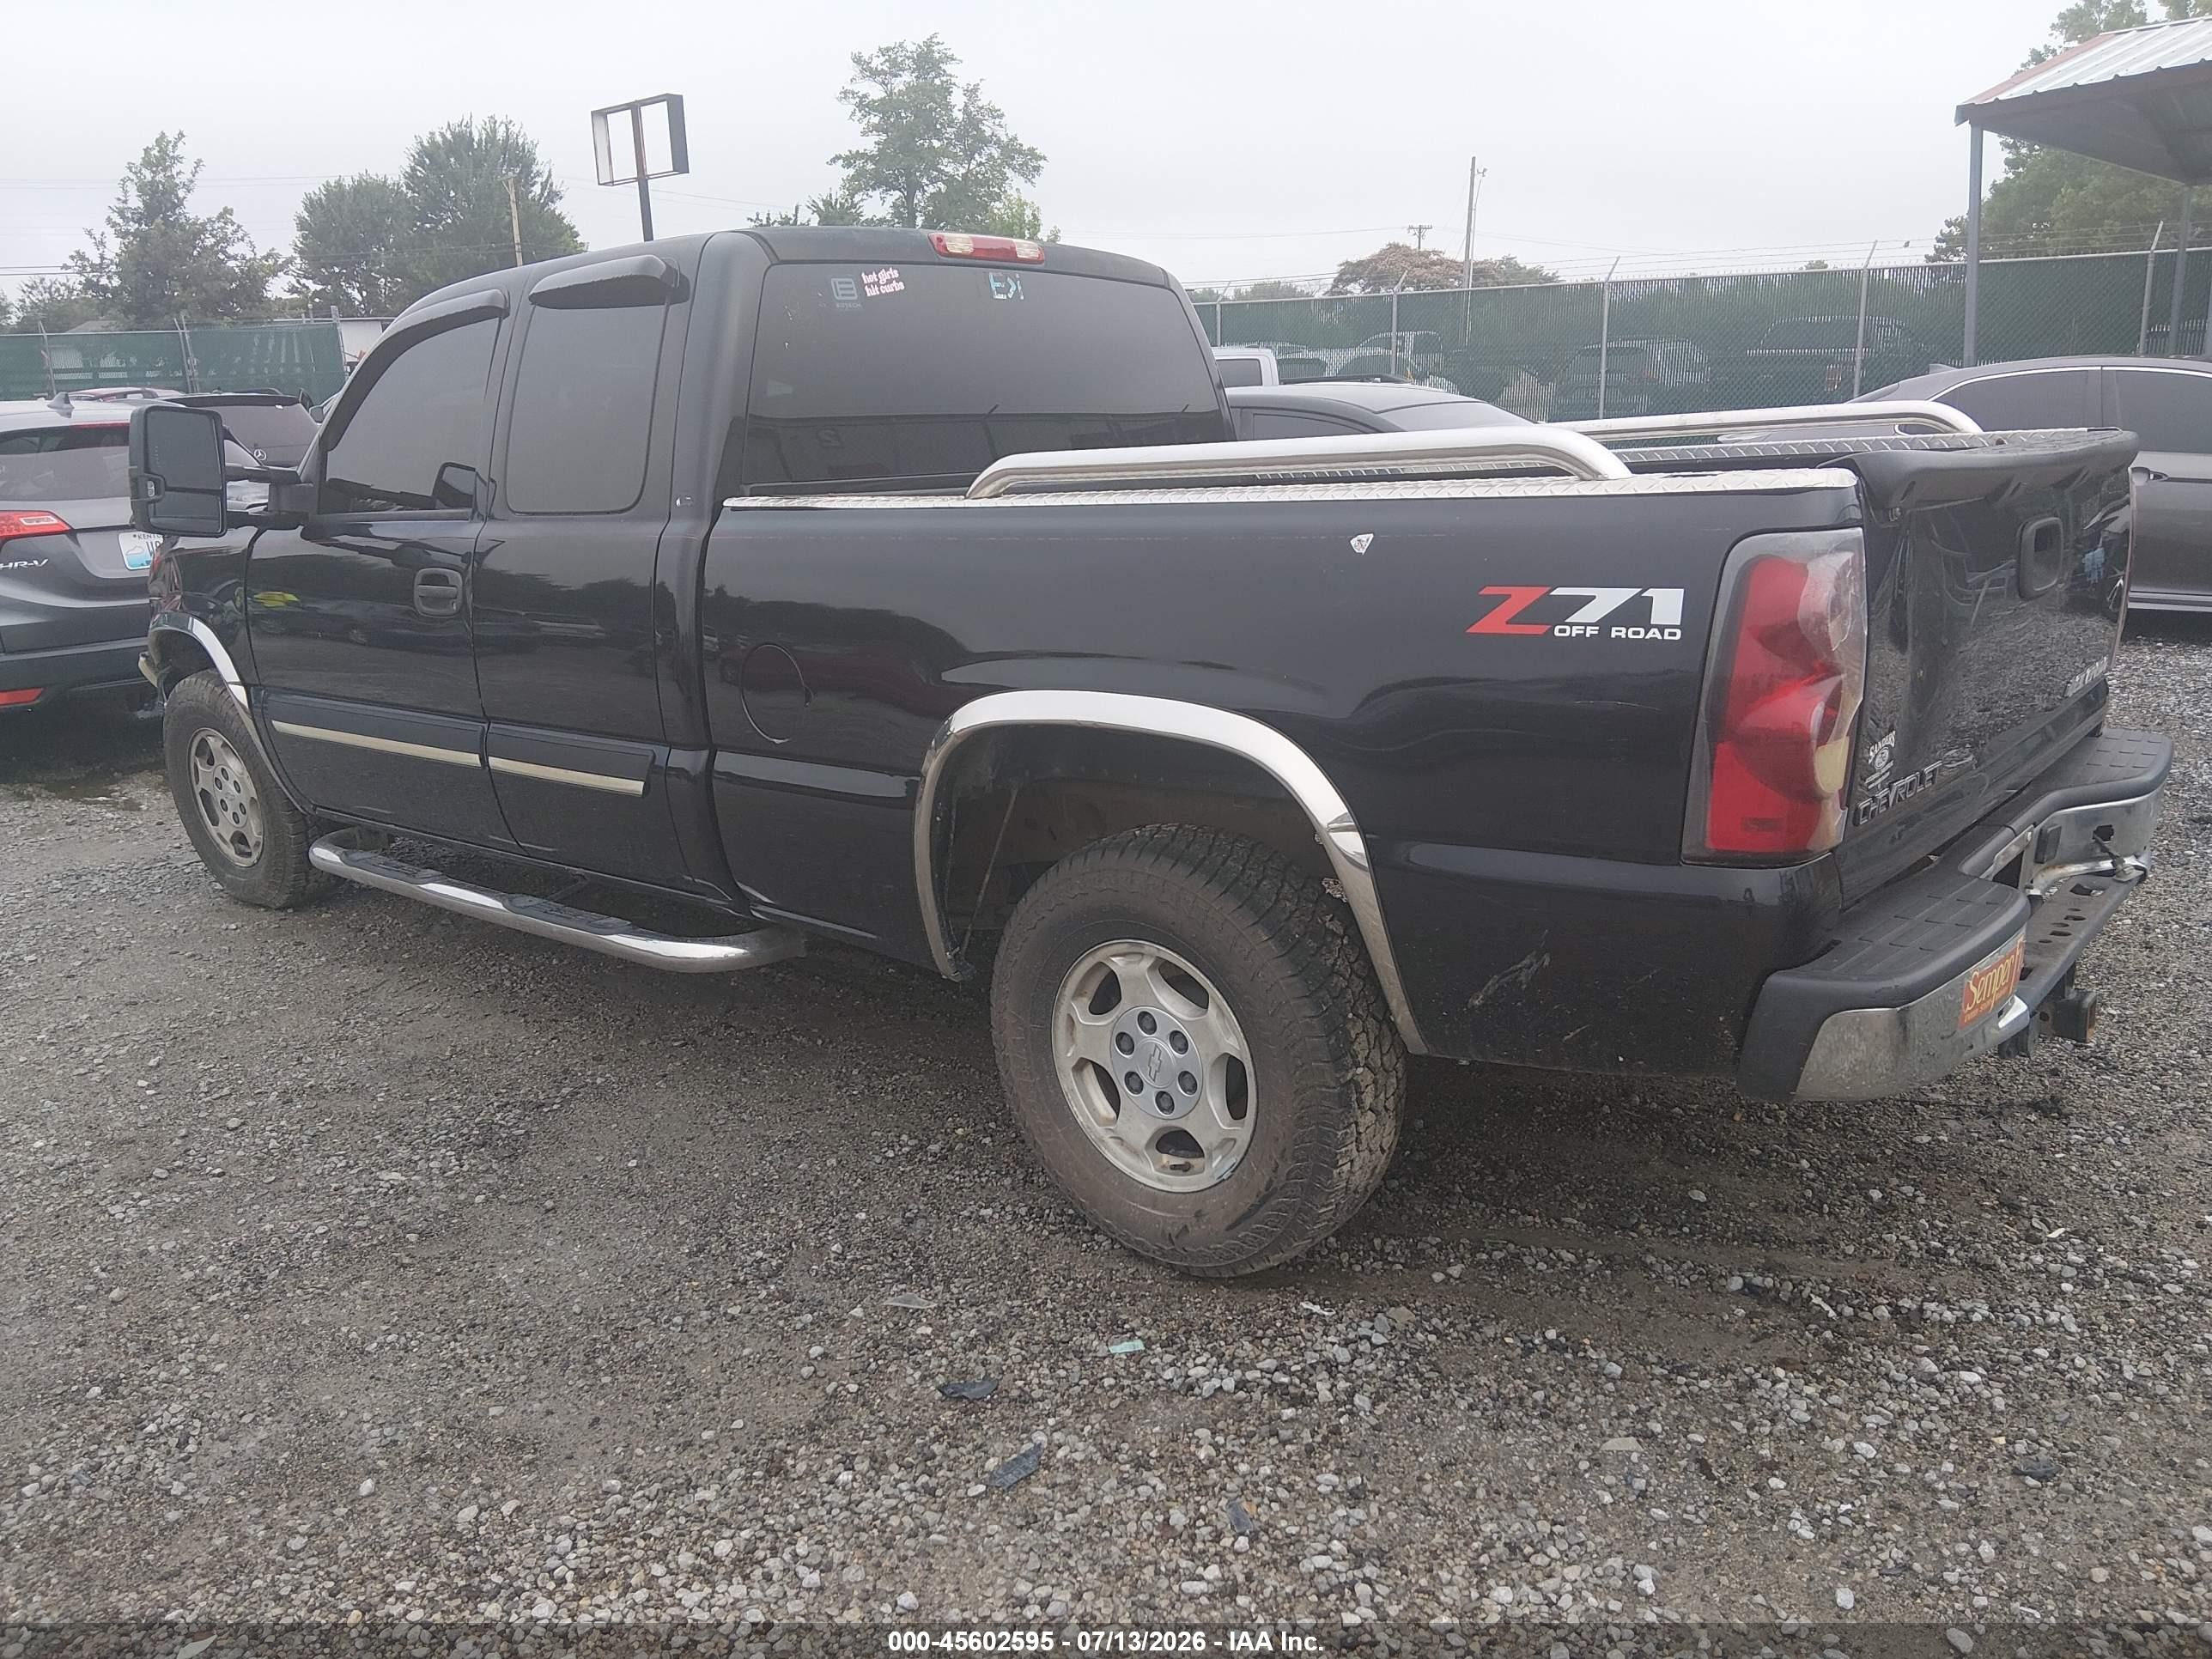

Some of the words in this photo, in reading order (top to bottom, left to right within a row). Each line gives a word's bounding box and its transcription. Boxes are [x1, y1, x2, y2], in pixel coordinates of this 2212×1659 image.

[861, 271, 878, 284] hot
[878, 267, 899, 284] girls
[864, 283, 880, 297] hit
[880, 280, 905, 294] curbs
[0, 558, 49, 570] HR-V
[1465, 586, 1685, 635] Z71
[1553, 625, 1601, 639] OFF
[1611, 626, 1681, 641] ROAD
[1868, 730, 1896, 764] SANDERS
[1857, 760, 1943, 826] CHEVROLET
[1965, 954, 2015, 1012] Semper
